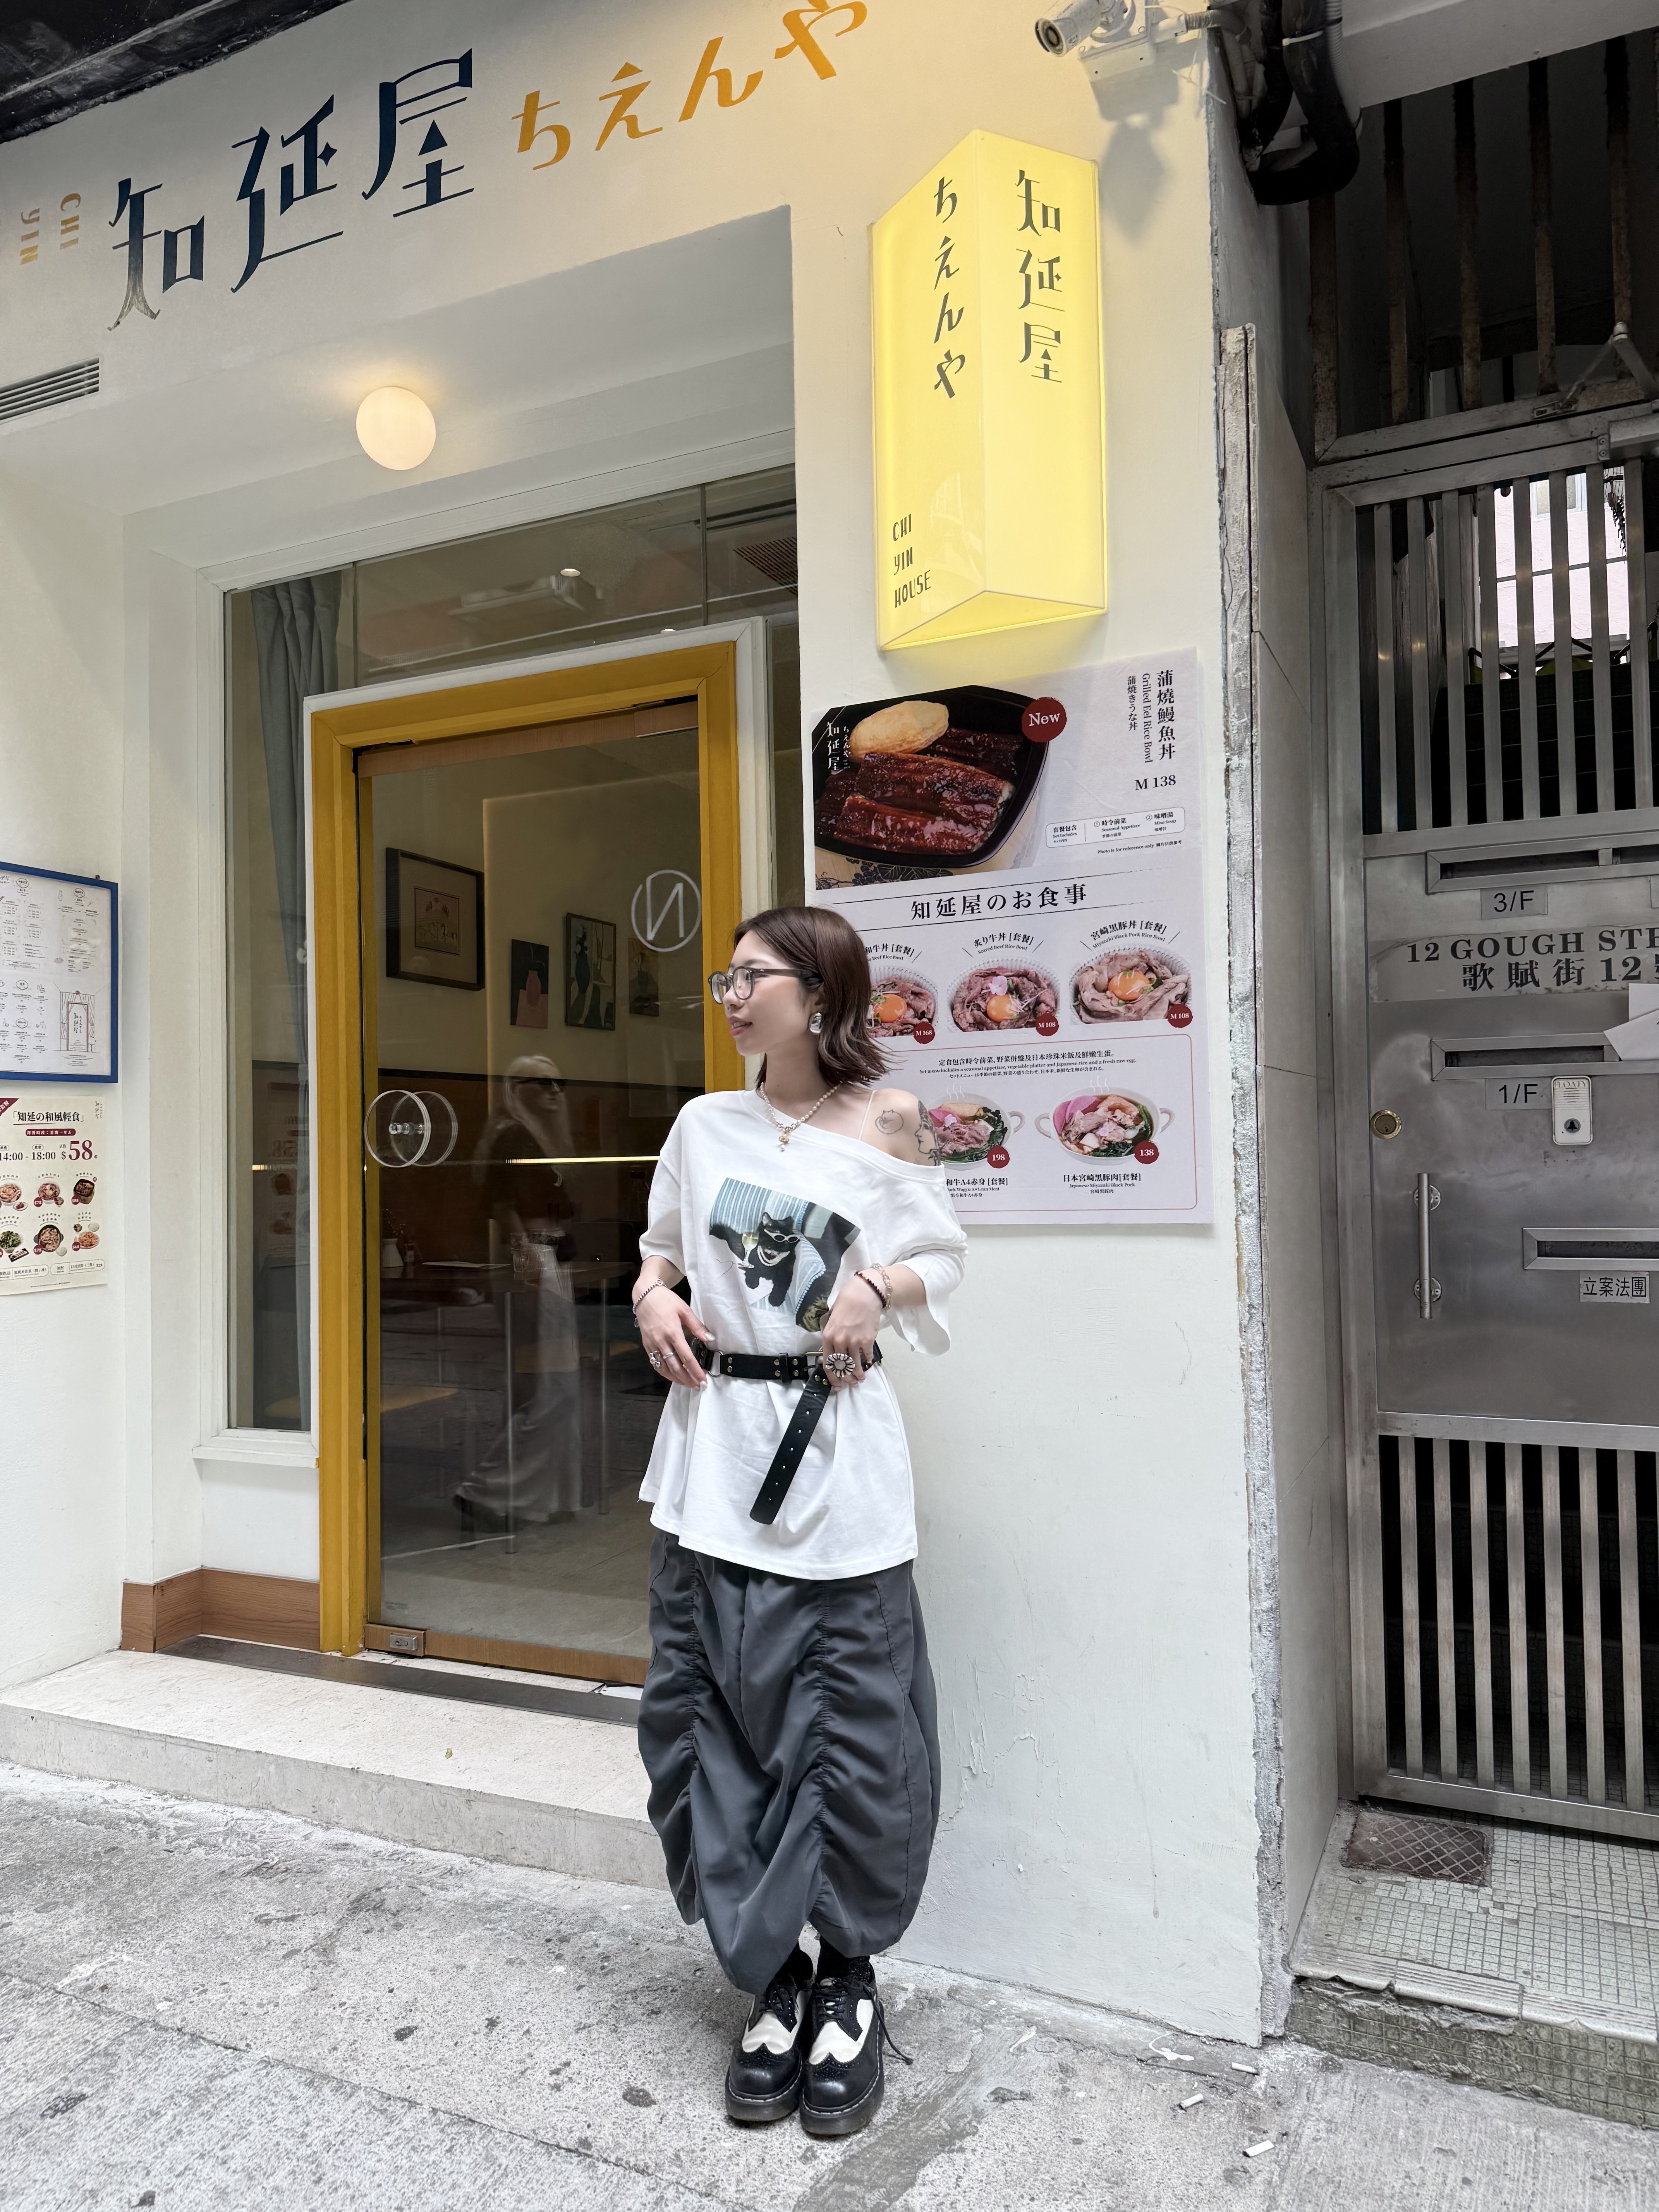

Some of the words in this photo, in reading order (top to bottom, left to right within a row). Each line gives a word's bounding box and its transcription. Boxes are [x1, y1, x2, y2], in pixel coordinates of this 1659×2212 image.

[511, 0, 867, 171] ちえんや
[107, 48, 475, 331] 知延屋
[60, 192, 81, 250] CHI
[19, 208, 40, 265] YIN
[933, 176, 965, 399] ちえんや
[1014, 169, 1065, 383] 知延屋
[893, 514, 912, 542] CHI
[893, 546, 914, 575] YIN
[894, 570, 931, 608] HOUSE
[1142, 673, 1151, 704] Grilled
[1028, 712, 1060, 726] New
[1143, 705, 1152, 719] Eel
[1156, 670, 1176, 761] 蒲燒鰻魚丼
[1144, 720, 1152, 740] Rice
[826, 721, 841, 771] 知延屋
[1144, 742, 1153, 763] Bowl
[1134, 778, 1149, 790] M
[1152, 775, 1176, 788] 138
[911, 883, 1087, 920] 知延屋のお食事
[1493, 890, 1535, 913] 3/F
[977, 946, 993, 955] Seared
[1092, 936, 1114, 949] Miyazaki
[1407, 942, 1440, 963] 12
[1450, 932, 1585, 960] GOUGH
[1498, 1084, 1539, 1104] 1/F
[31, 1151, 56, 1160] 18:00
[1583, 1276, 1647, 1298] 立案法團
